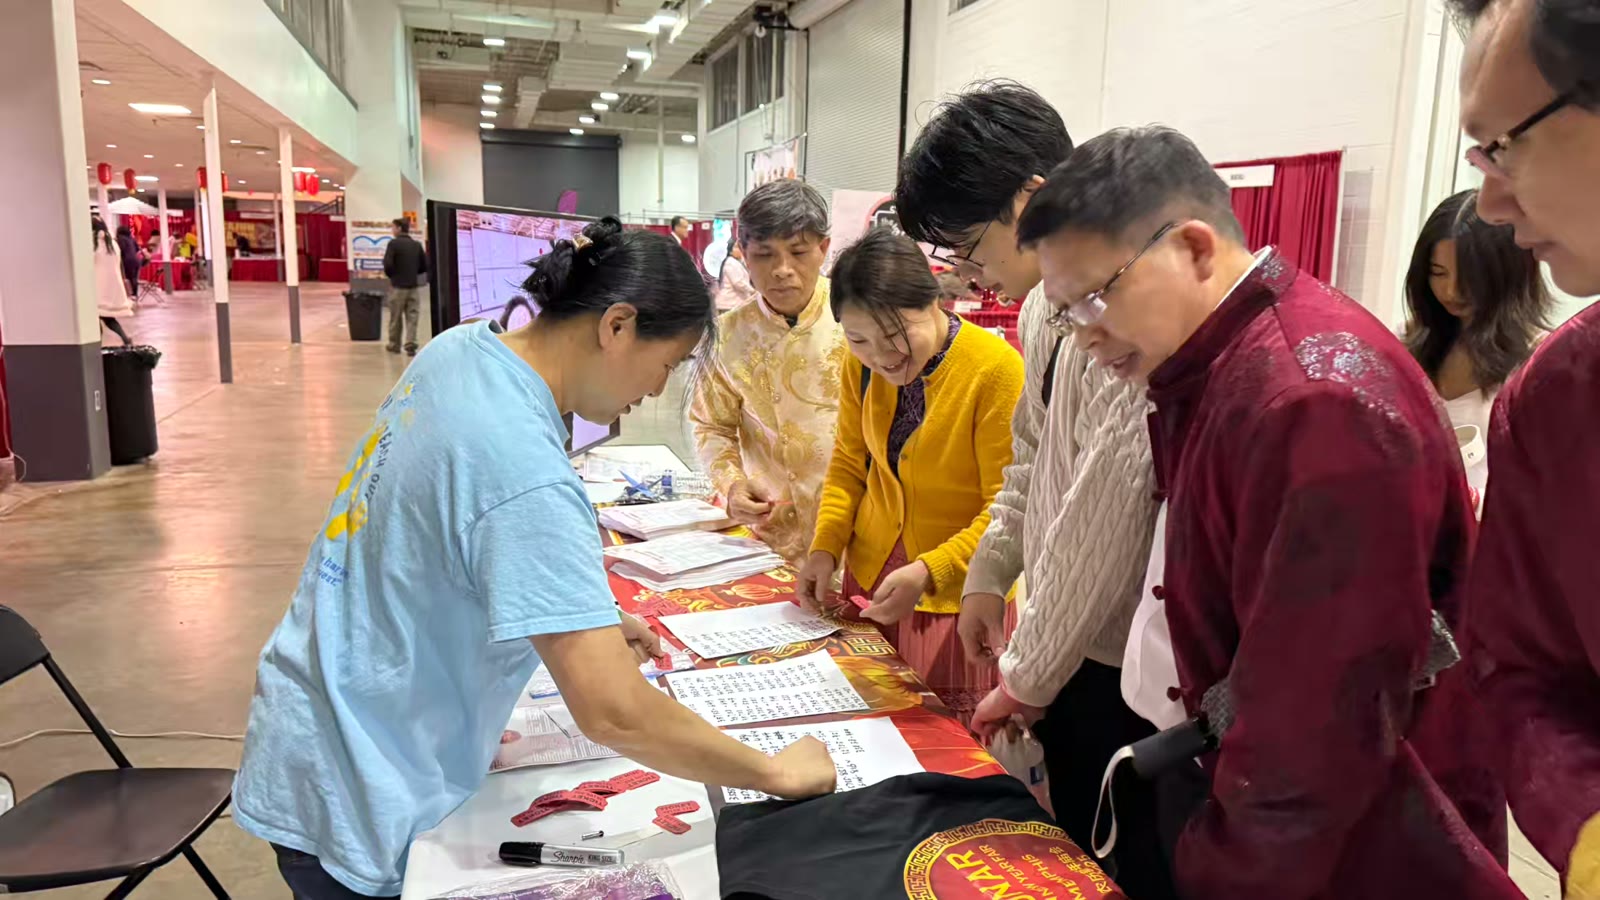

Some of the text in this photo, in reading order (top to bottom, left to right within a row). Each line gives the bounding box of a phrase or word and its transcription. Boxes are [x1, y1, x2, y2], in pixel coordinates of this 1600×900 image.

[550, 850, 585, 864] Sharpie
[978, 844, 1001, 863] FAIR
[999, 861, 1029, 884] YEAR
[1021, 853, 1087, 900] MEMPHIS
